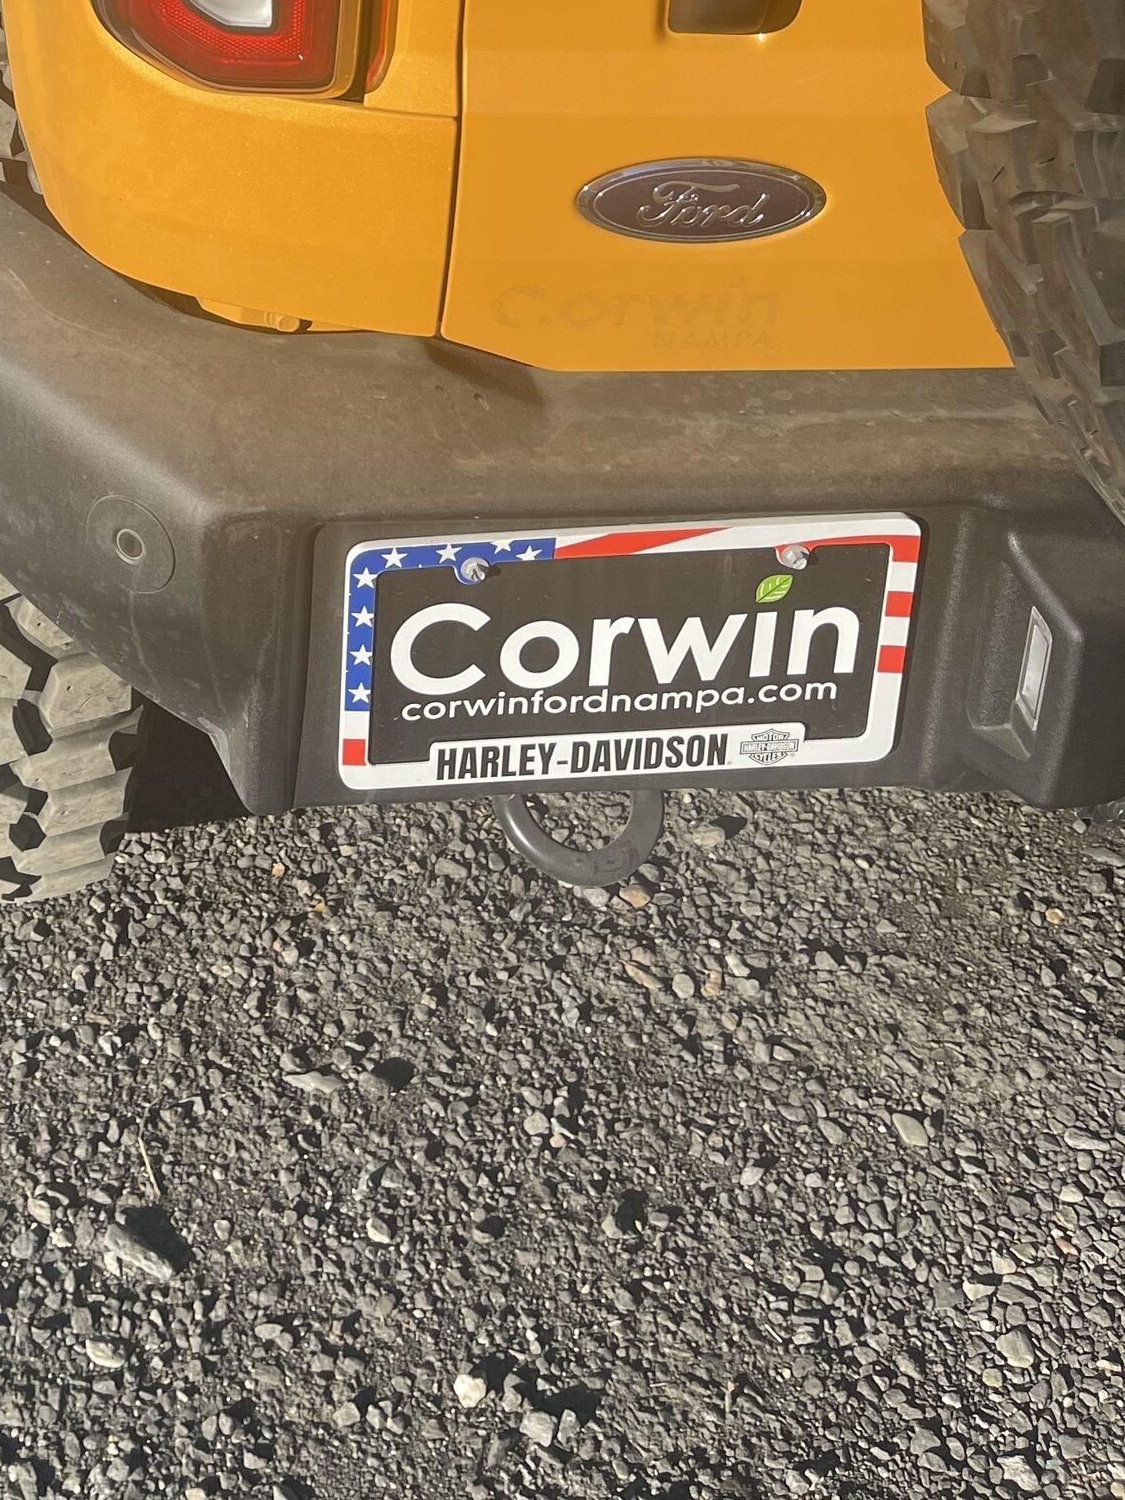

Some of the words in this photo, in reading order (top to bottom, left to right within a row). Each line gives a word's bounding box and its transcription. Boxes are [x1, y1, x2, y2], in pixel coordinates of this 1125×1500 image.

[636, 180, 770, 228] Ford
[489, 283, 783, 327] Corwin
[390, 601, 860, 696] Corwin
[401, 681, 838, 721] corwinfordnampa.com
[436, 733, 729, 781] HARLEY-DAVIDSON
